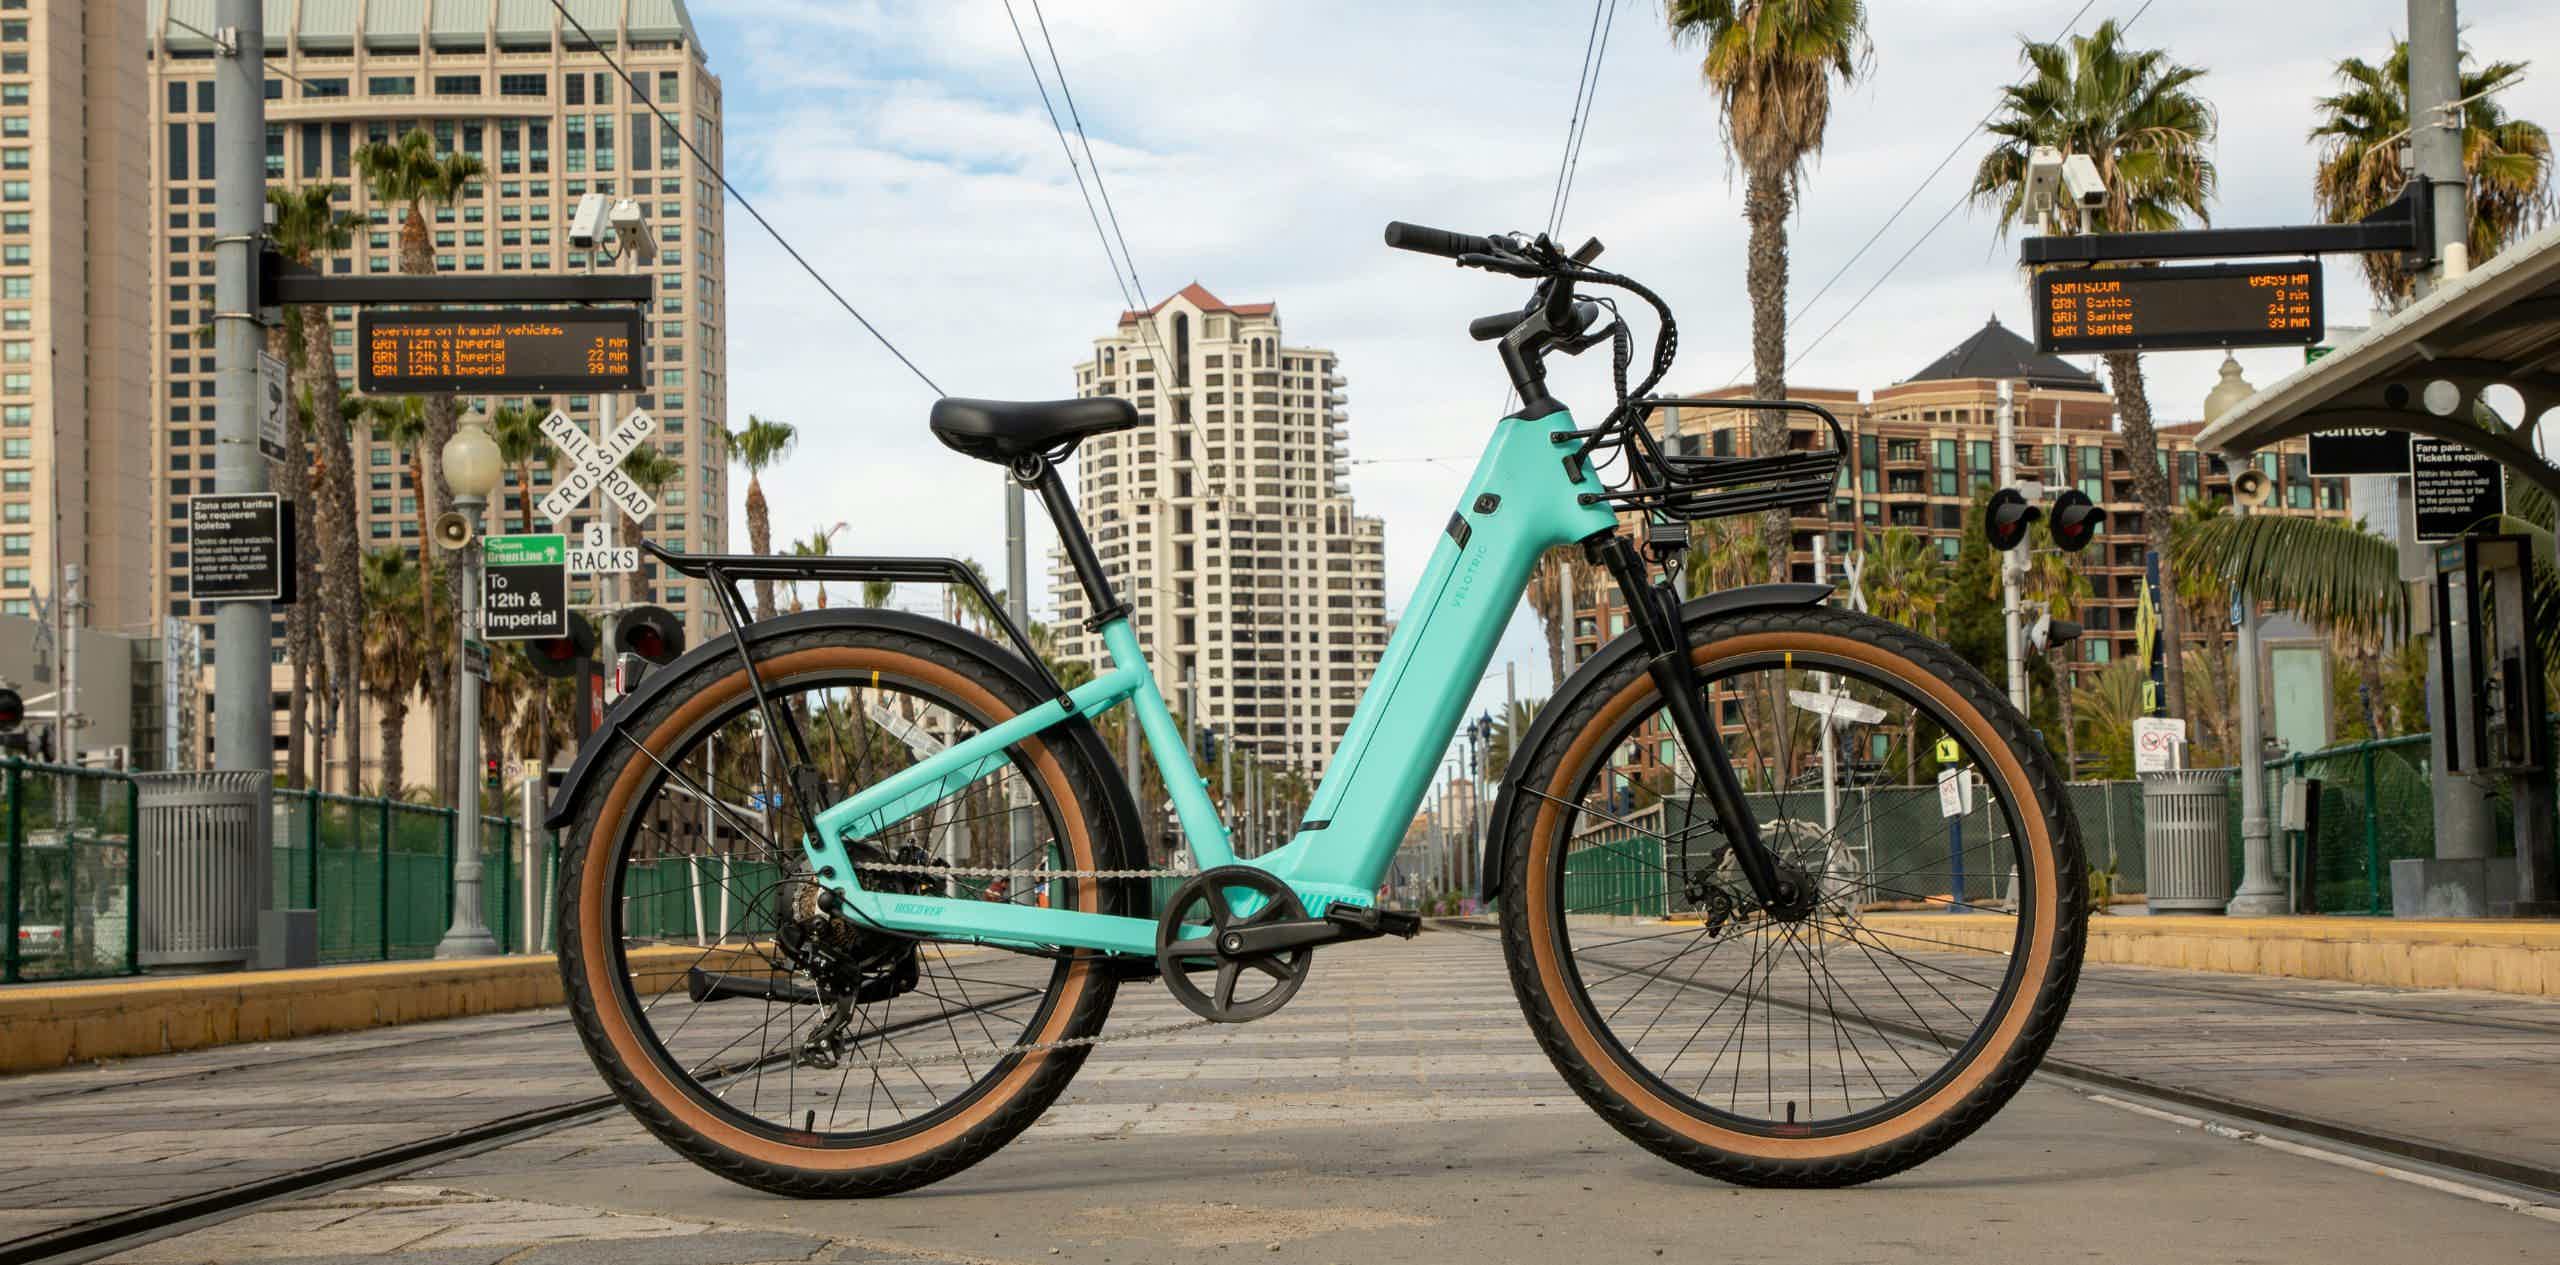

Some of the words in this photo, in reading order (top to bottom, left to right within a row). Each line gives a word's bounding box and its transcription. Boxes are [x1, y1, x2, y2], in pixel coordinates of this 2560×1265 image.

[2289, 289, 2310, 300] min
[2052, 297, 2077, 309] GRN
[2268, 303, 2285, 314] 24
[2290, 303, 2310, 314] min
[2052, 311, 2077, 322] GRN
[2290, 317, 2311, 328] min
[434, 328, 451, 336] on
[2087, 324, 2133, 335] Santee
[372, 339, 397, 350] GRN
[409, 339, 437, 349] 12th
[441, 339, 450, 349] &
[456, 338, 505, 350] Imperial
[609, 337, 628, 347] min
[372, 351, 398, 363] GRN
[409, 351, 437, 363] 12th
[441, 351, 450, 362] &
[456, 351, 505, 363] Imperial
[588, 351, 604, 361] 22
[609, 350, 628, 361] min
[372, 365, 398, 376] GRN
[409, 365, 437, 375] 12th
[441, 365, 450, 375] &
[456, 364, 505, 376] Imperial
[588, 363, 604, 374] 39
[609, 364, 628, 374] min
[2416, 444, 2438, 453] Fare
[2417, 454, 2452, 462] Tickets
[547, 415, 648, 516] CROSSING
[194, 502, 219, 510] Zona
[221, 502, 240, 510] con
[242, 500, 273, 509] tarifas
[209, 511, 257, 520] requieren
[194, 521, 231, 530] boletos
[592, 528, 604, 547] 3
[567, 550, 634, 570] RACKS
[488, 574, 507, 589] To
[1452, 545, 1487, 608] VELOTRIC
[488, 593, 524, 608] 12th
[529, 592, 542, 607] &
[488, 610, 557, 629] Imperial
